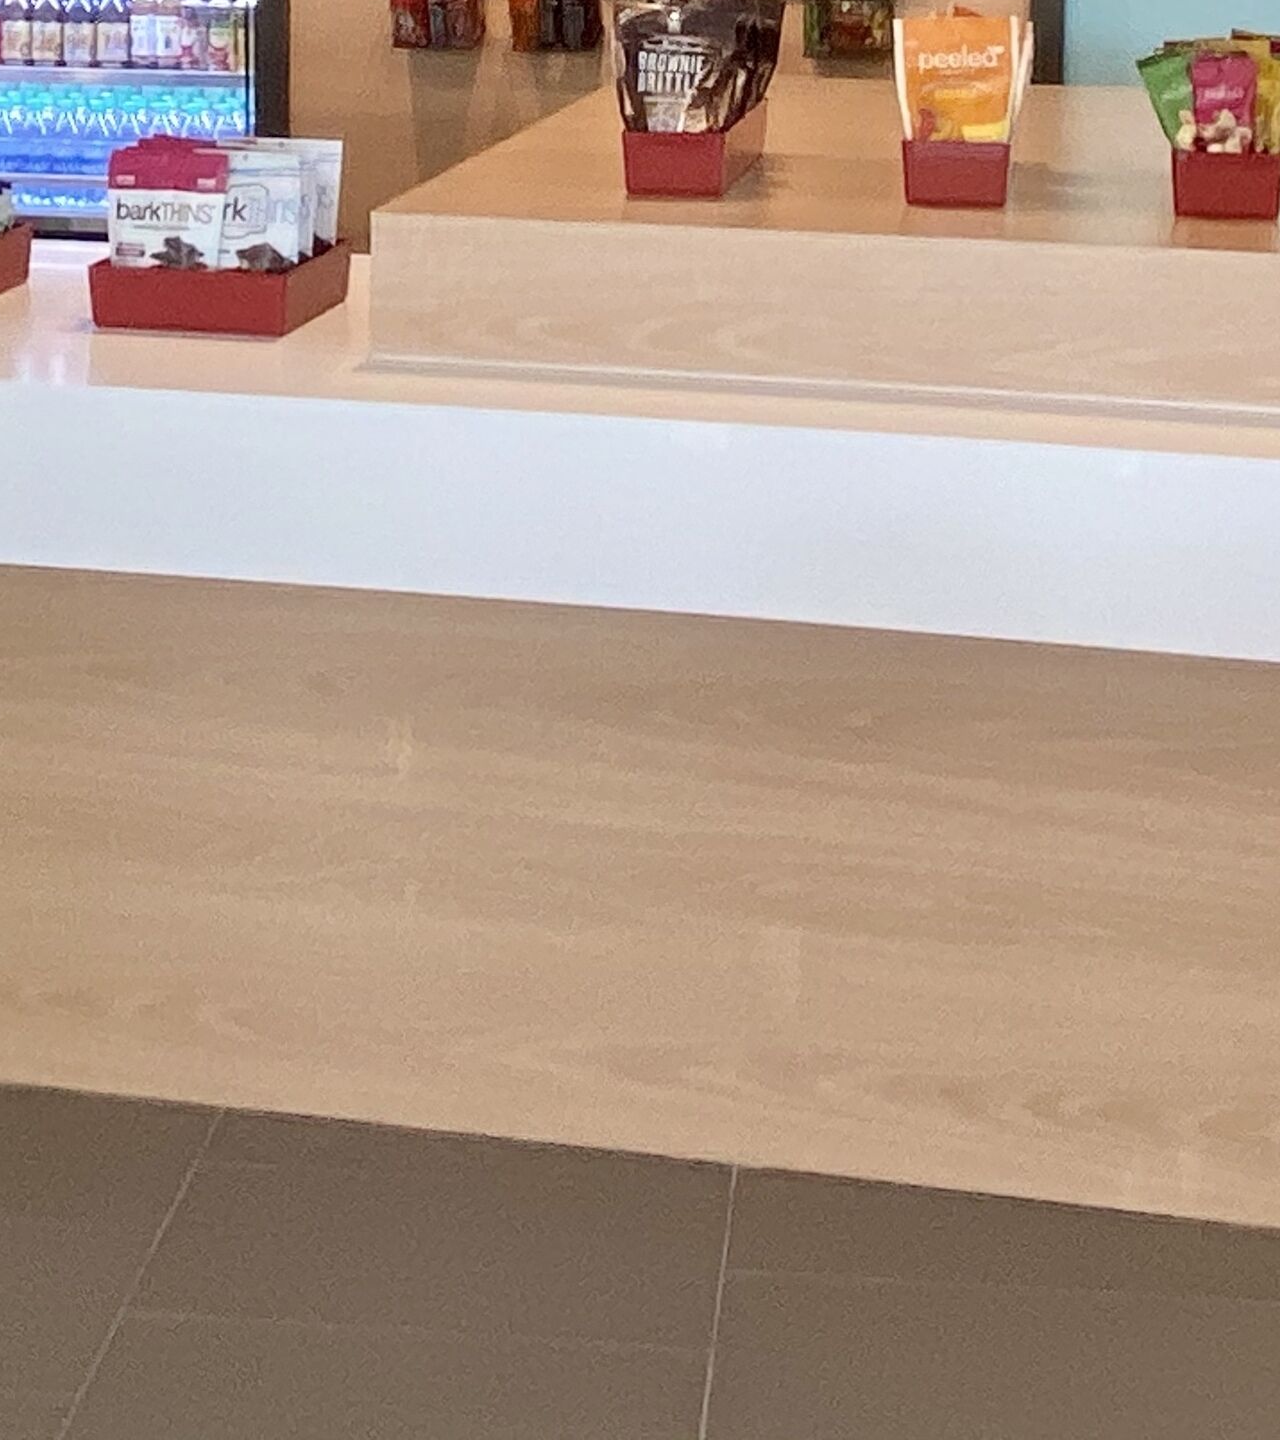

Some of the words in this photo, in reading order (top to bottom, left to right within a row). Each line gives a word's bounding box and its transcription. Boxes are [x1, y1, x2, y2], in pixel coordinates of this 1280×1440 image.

[637, 51, 706, 74] BROWNIE
[918, 43, 1001, 74] peeled
[116, 198, 212, 222] barkTHINS
